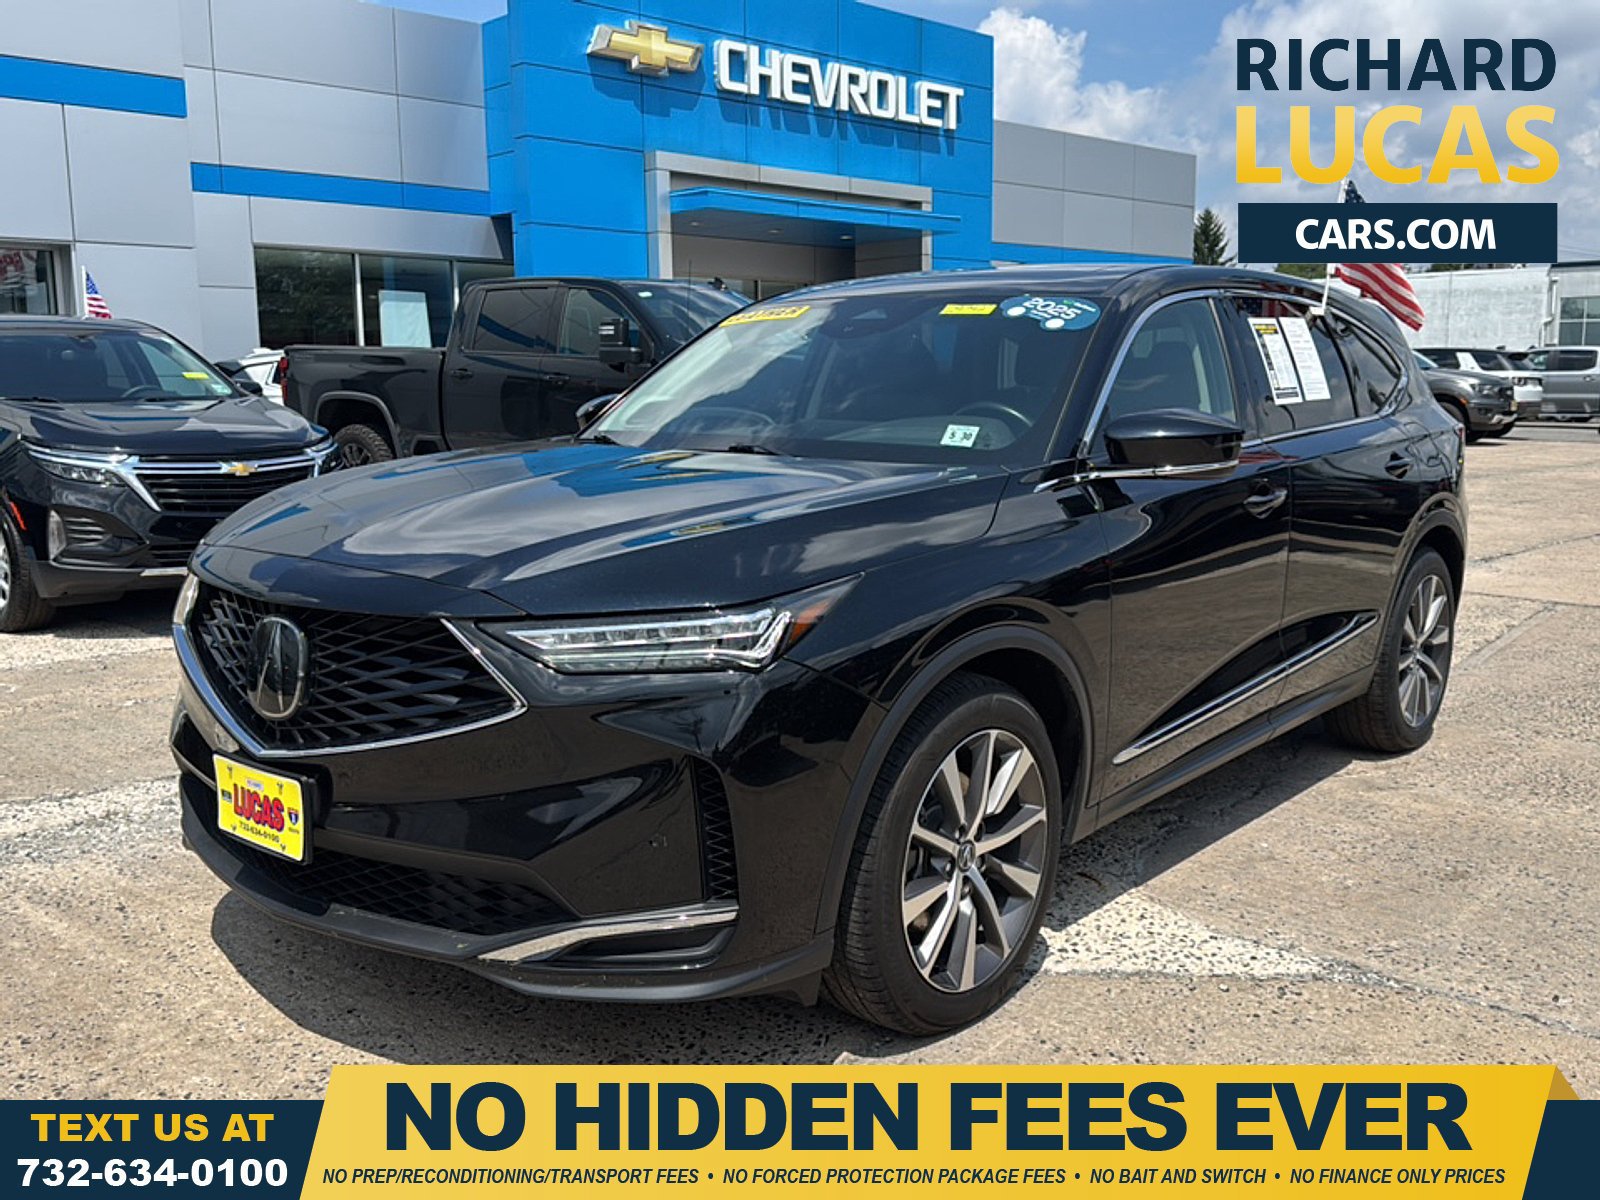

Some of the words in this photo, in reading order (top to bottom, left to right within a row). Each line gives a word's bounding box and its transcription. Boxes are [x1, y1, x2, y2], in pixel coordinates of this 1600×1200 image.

[714, 39, 964, 129] CHEVROLET
[1023, 297, 1081, 319] 2025
[233, 783, 285, 832] LUCAS
